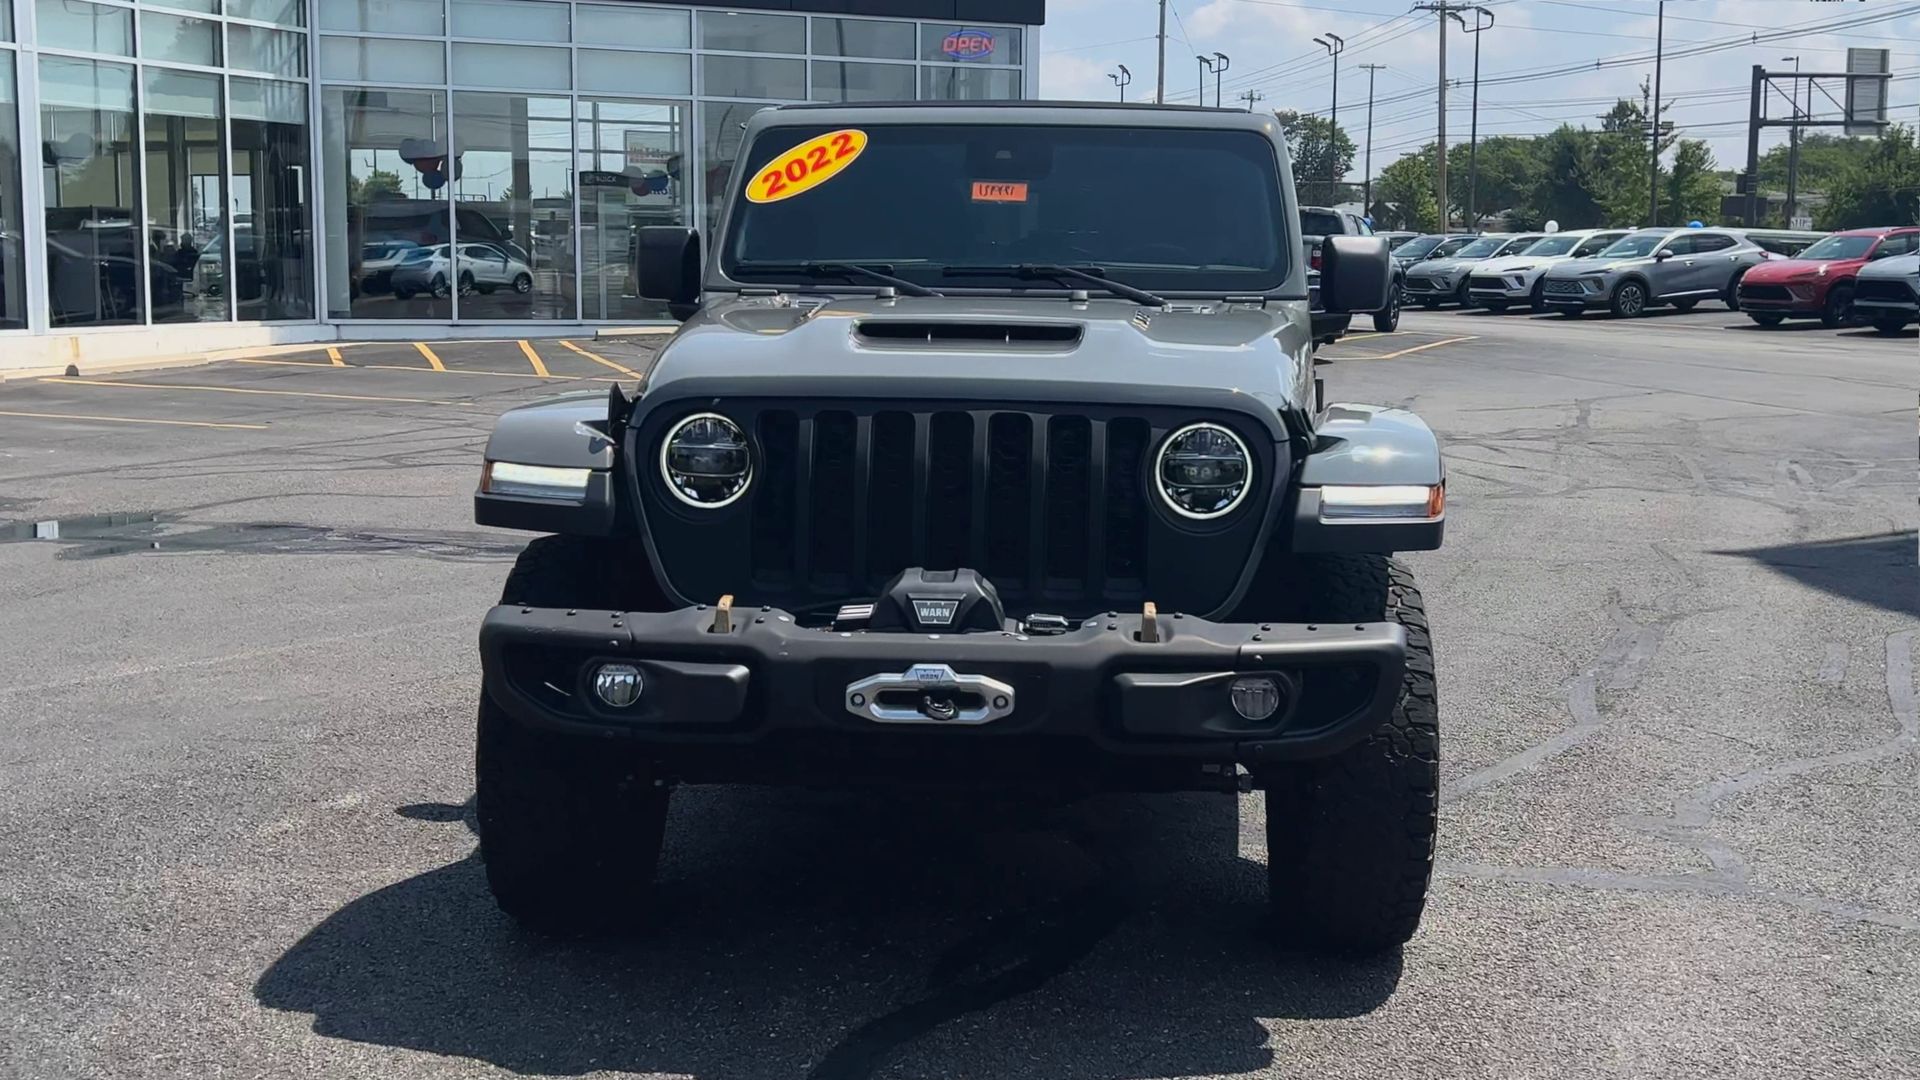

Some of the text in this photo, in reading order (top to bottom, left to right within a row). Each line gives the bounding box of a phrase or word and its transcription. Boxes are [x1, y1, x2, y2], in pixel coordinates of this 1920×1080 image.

[943, 37, 995, 52] OPEN
[762, 133, 857, 198] 2022
[920, 607, 950, 617] WARN
